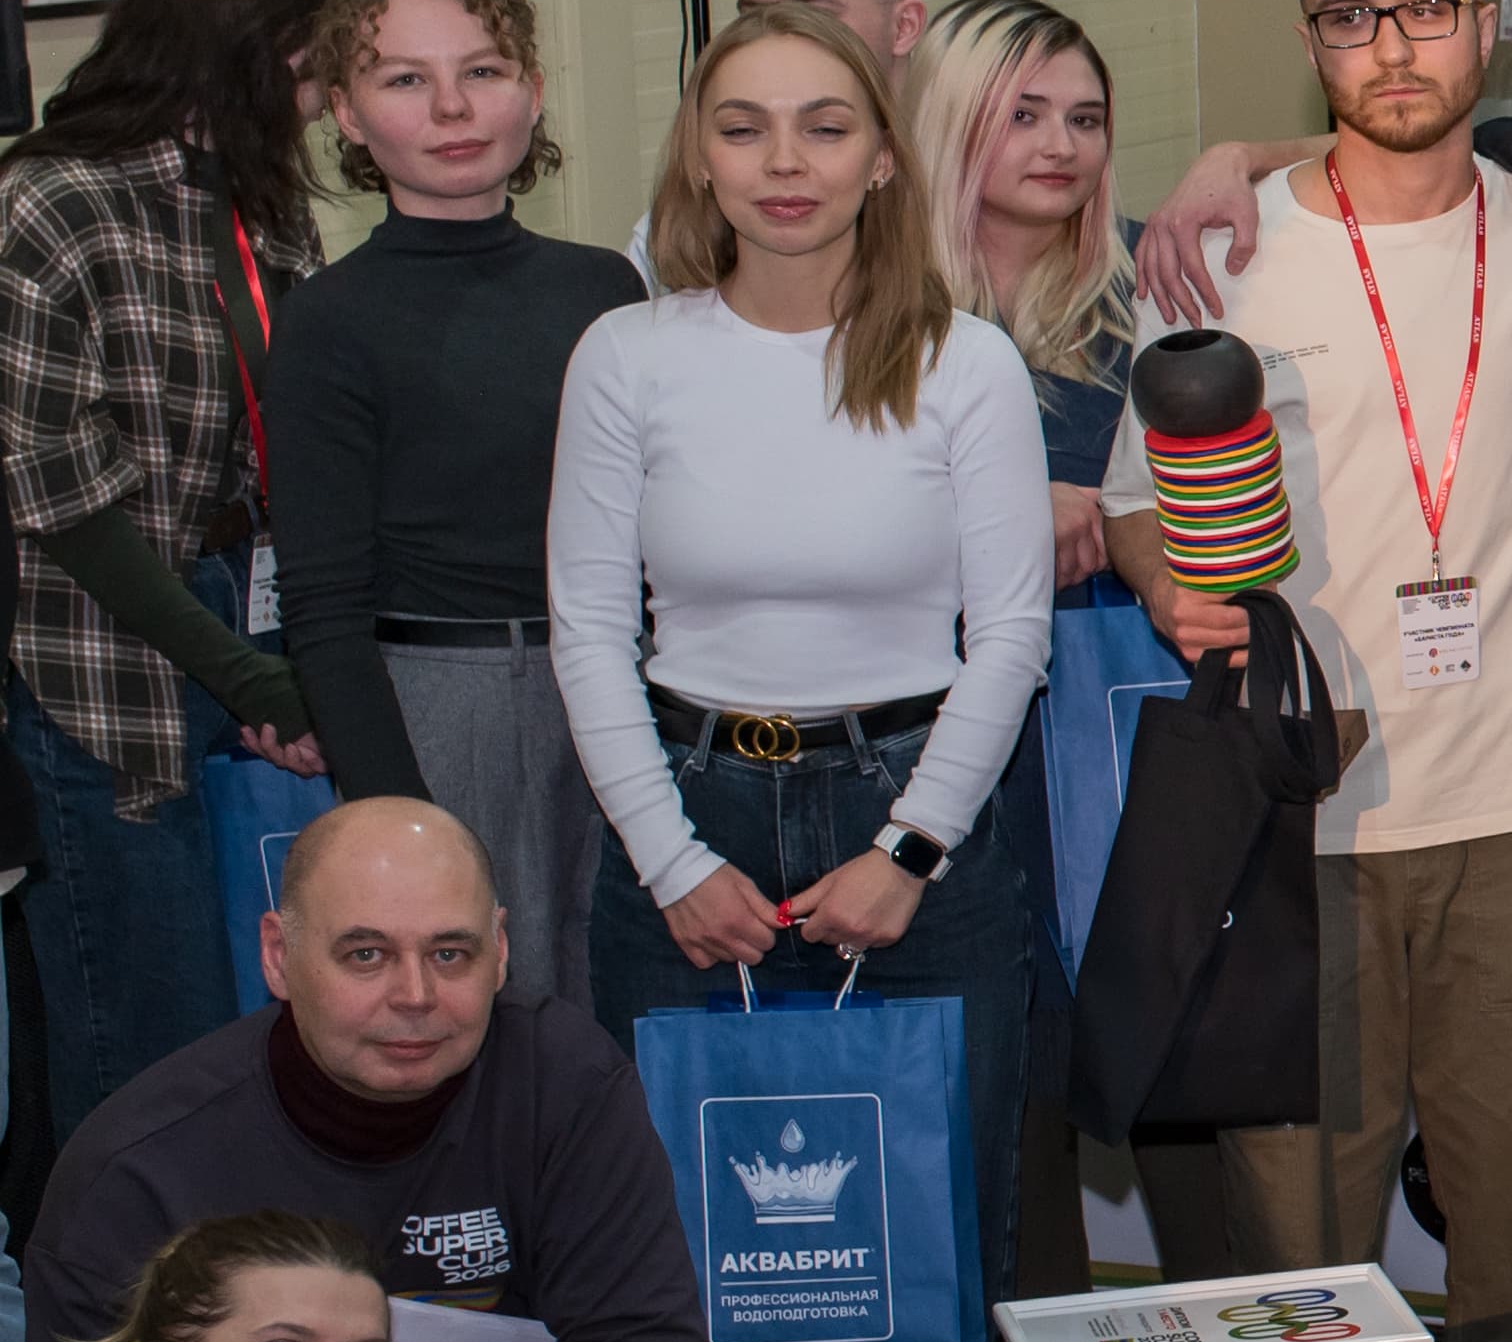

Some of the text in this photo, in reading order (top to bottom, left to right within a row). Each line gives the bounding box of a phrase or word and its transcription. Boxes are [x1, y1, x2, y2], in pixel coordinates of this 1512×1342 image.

[1346, 215, 1360, 241] ATLAS
[1363, 267, 1377, 295] ATLAS
[1380, 322, 1393, 350] ATLAS
[1473, 315, 1482, 343] ATLAS
[1396, 380, 1407, 407] ATLAS
[400, 1208, 502, 1239] OFFEE
[437, 1245, 509, 1271] CUP
[721, 1249, 869, 1274] АКВАБРИТ
[444, 1259, 512, 1284] 2026
[721, 1289, 880, 1308] ПРОФЕССИОНАЛЬНАЯ
[733, 1305, 869, 1323] ВОДОПОДГОТОВКА
